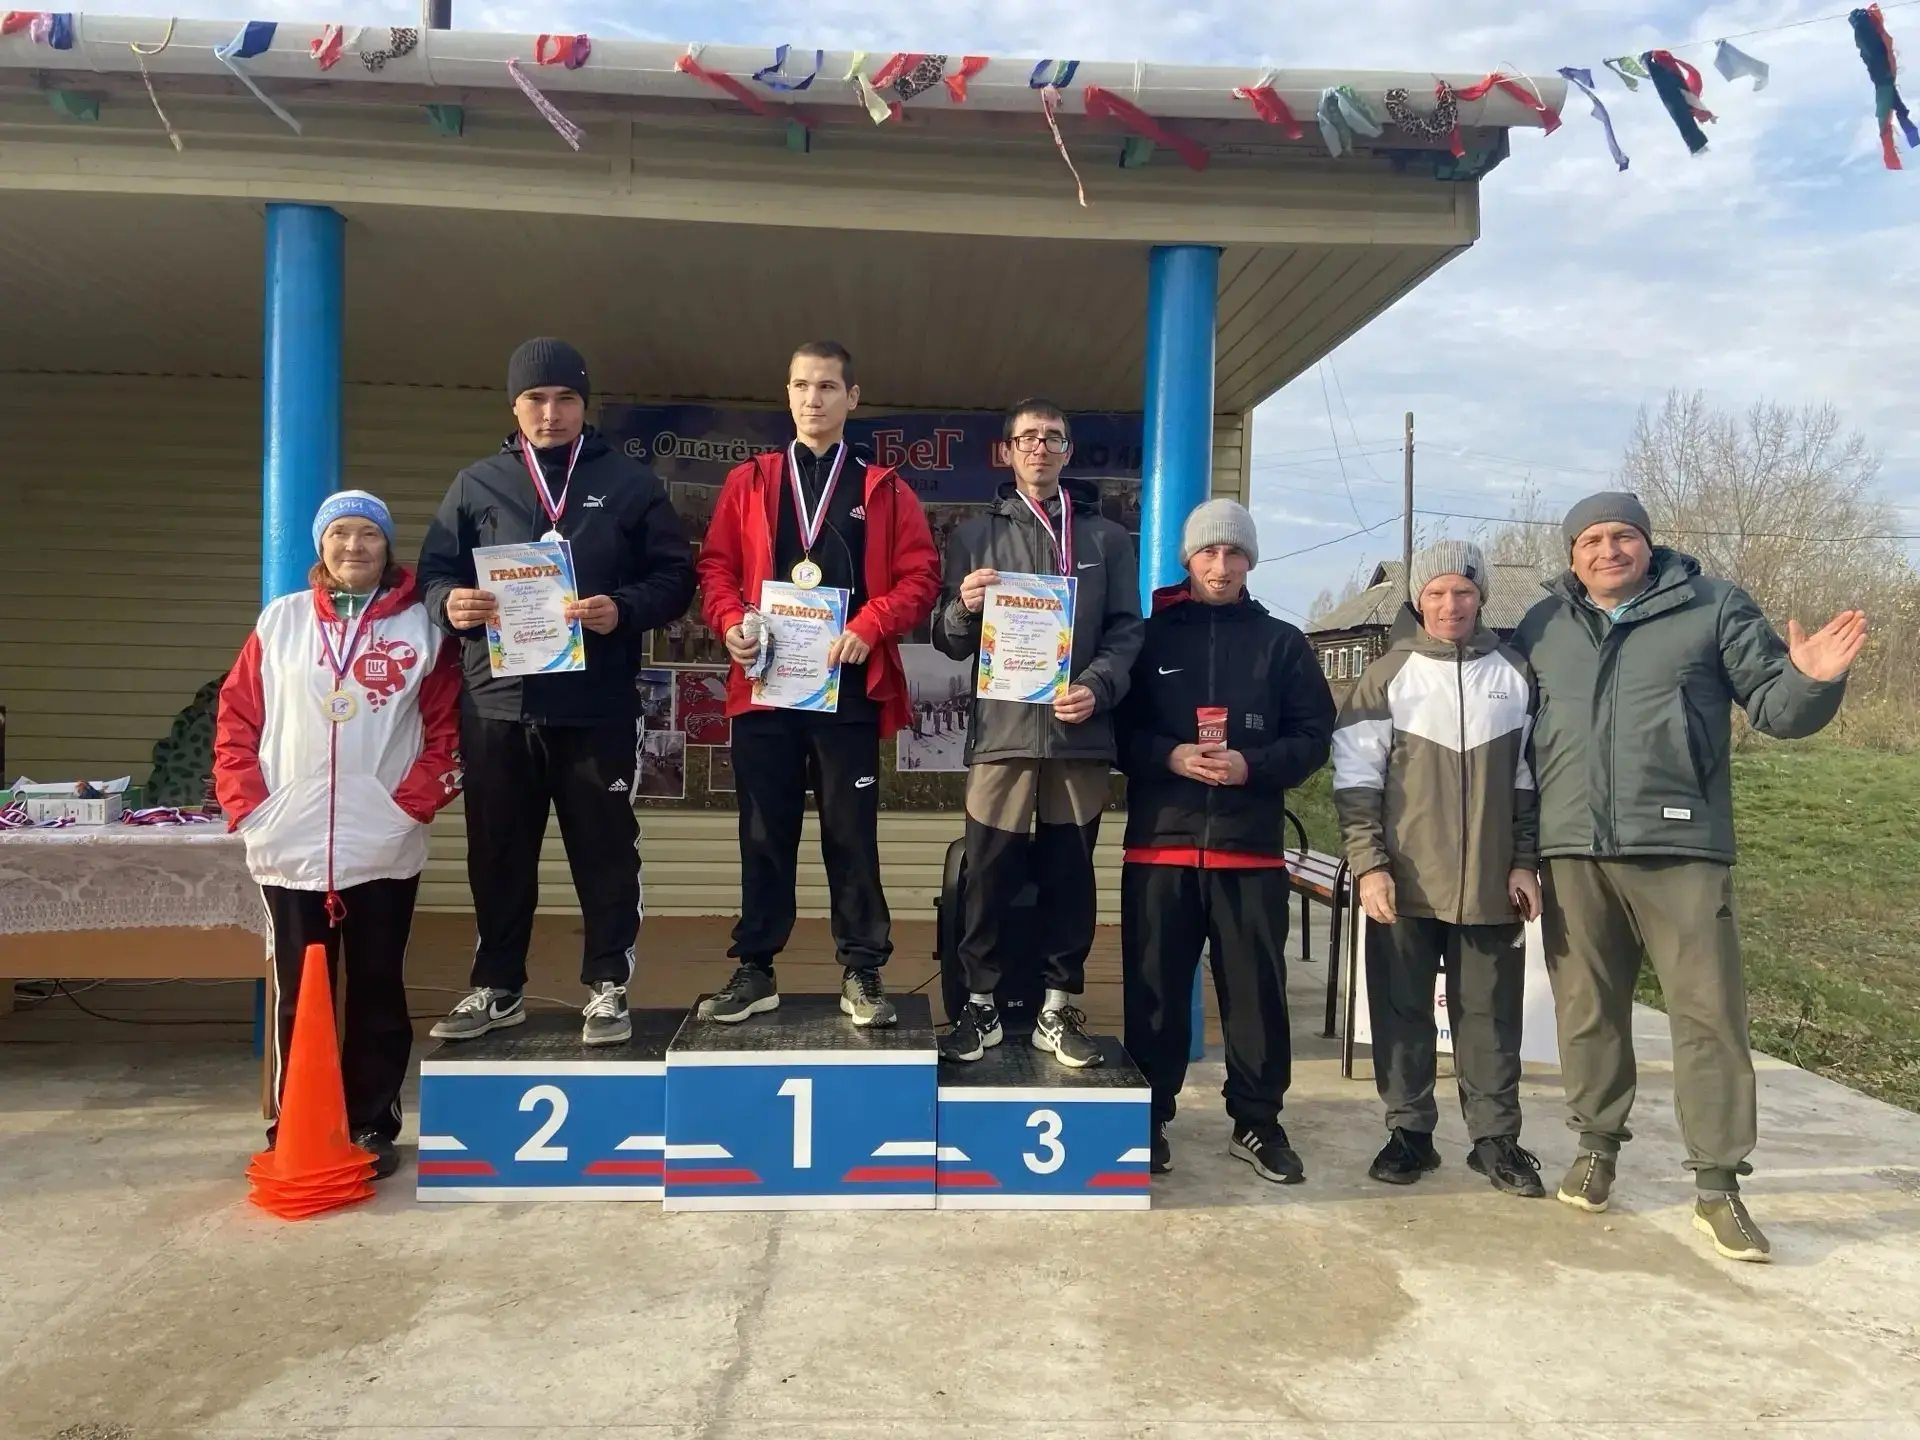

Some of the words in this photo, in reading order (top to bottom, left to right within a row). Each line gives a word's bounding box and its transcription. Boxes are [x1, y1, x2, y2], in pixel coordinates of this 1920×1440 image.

[624, 438, 647, 457] с.
[488, 564, 562, 582] ГРАМОТА
[996, 594, 1064, 611] ГРАМОТА
[770, 603, 835, 621] ГРАМОТА
[1200, 729, 1223, 737] СТЕП
[514, 1085, 570, 1162] 2
[776, 1078, 813, 1169] 1
[1022, 1109, 1066, 1175] 3
